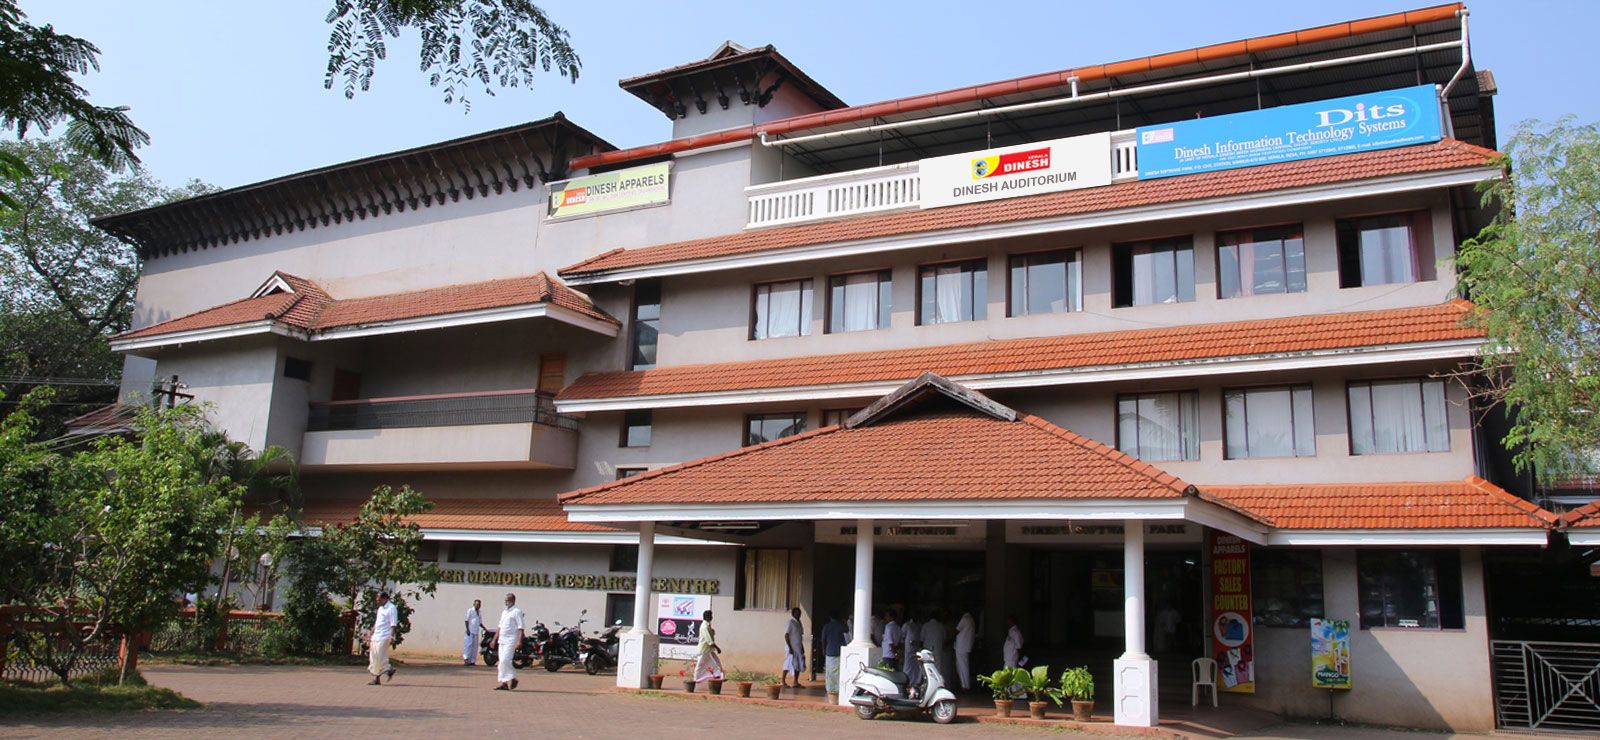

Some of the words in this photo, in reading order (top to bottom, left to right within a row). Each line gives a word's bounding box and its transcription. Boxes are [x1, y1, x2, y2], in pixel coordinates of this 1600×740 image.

[1315, 103, 1405, 128] Dits
[1174, 144, 1211, 160] Dinesh
[1216, 136, 1282, 153] Information
[1286, 126, 1354, 144] Technology
[1359, 119, 1406, 136] Systems
[1004, 158, 1048, 172] DINESH
[586, 182, 617, 197] DINESH
[620, 174, 664, 191] APPARELS
[953, 182, 998, 198] DINESH
[1001, 172, 1077, 191] AUDITORIUM
[1214, 559, 1246, 575] FACTORY
[468, 570, 552, 587] MEMORIAL
[1219, 576, 1242, 592] SALES
[1215, 594, 1248, 610] COUNTER
